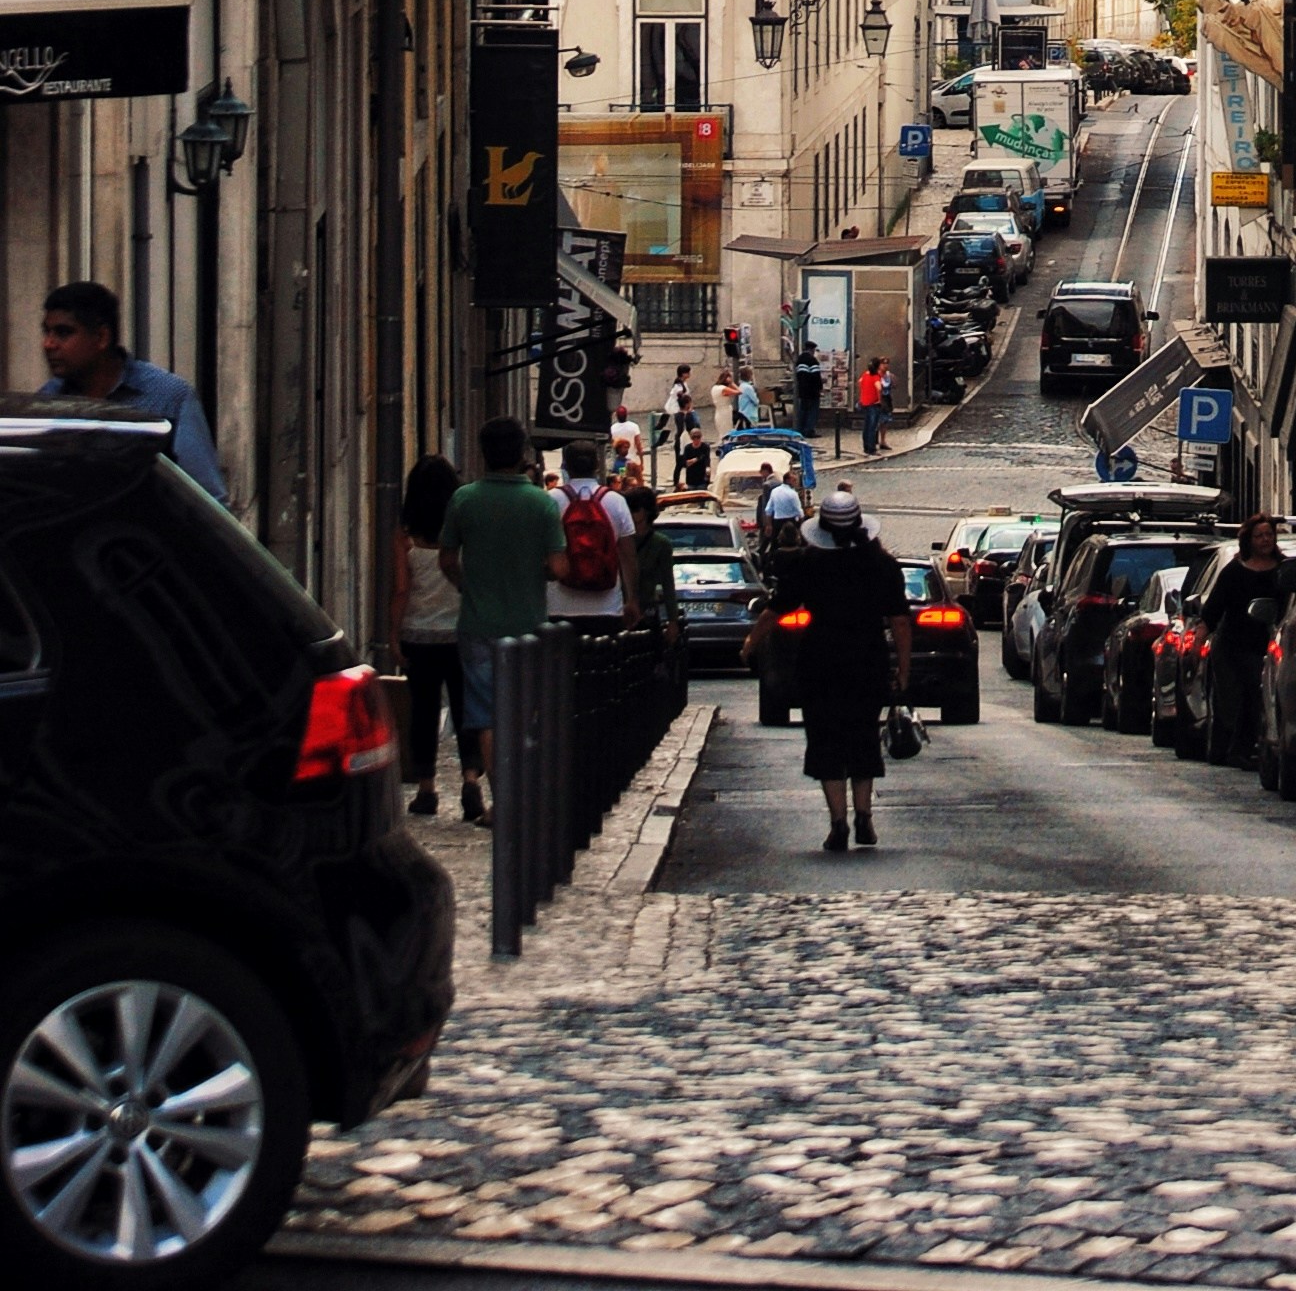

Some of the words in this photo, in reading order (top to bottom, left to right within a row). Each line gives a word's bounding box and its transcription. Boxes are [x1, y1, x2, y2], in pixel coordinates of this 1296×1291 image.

[907, 130, 924, 151] P
[995, 132, 1055, 159] mudanças
[1228, 276, 1267, 287] TORRES
[1190, 396, 1219, 435] P
